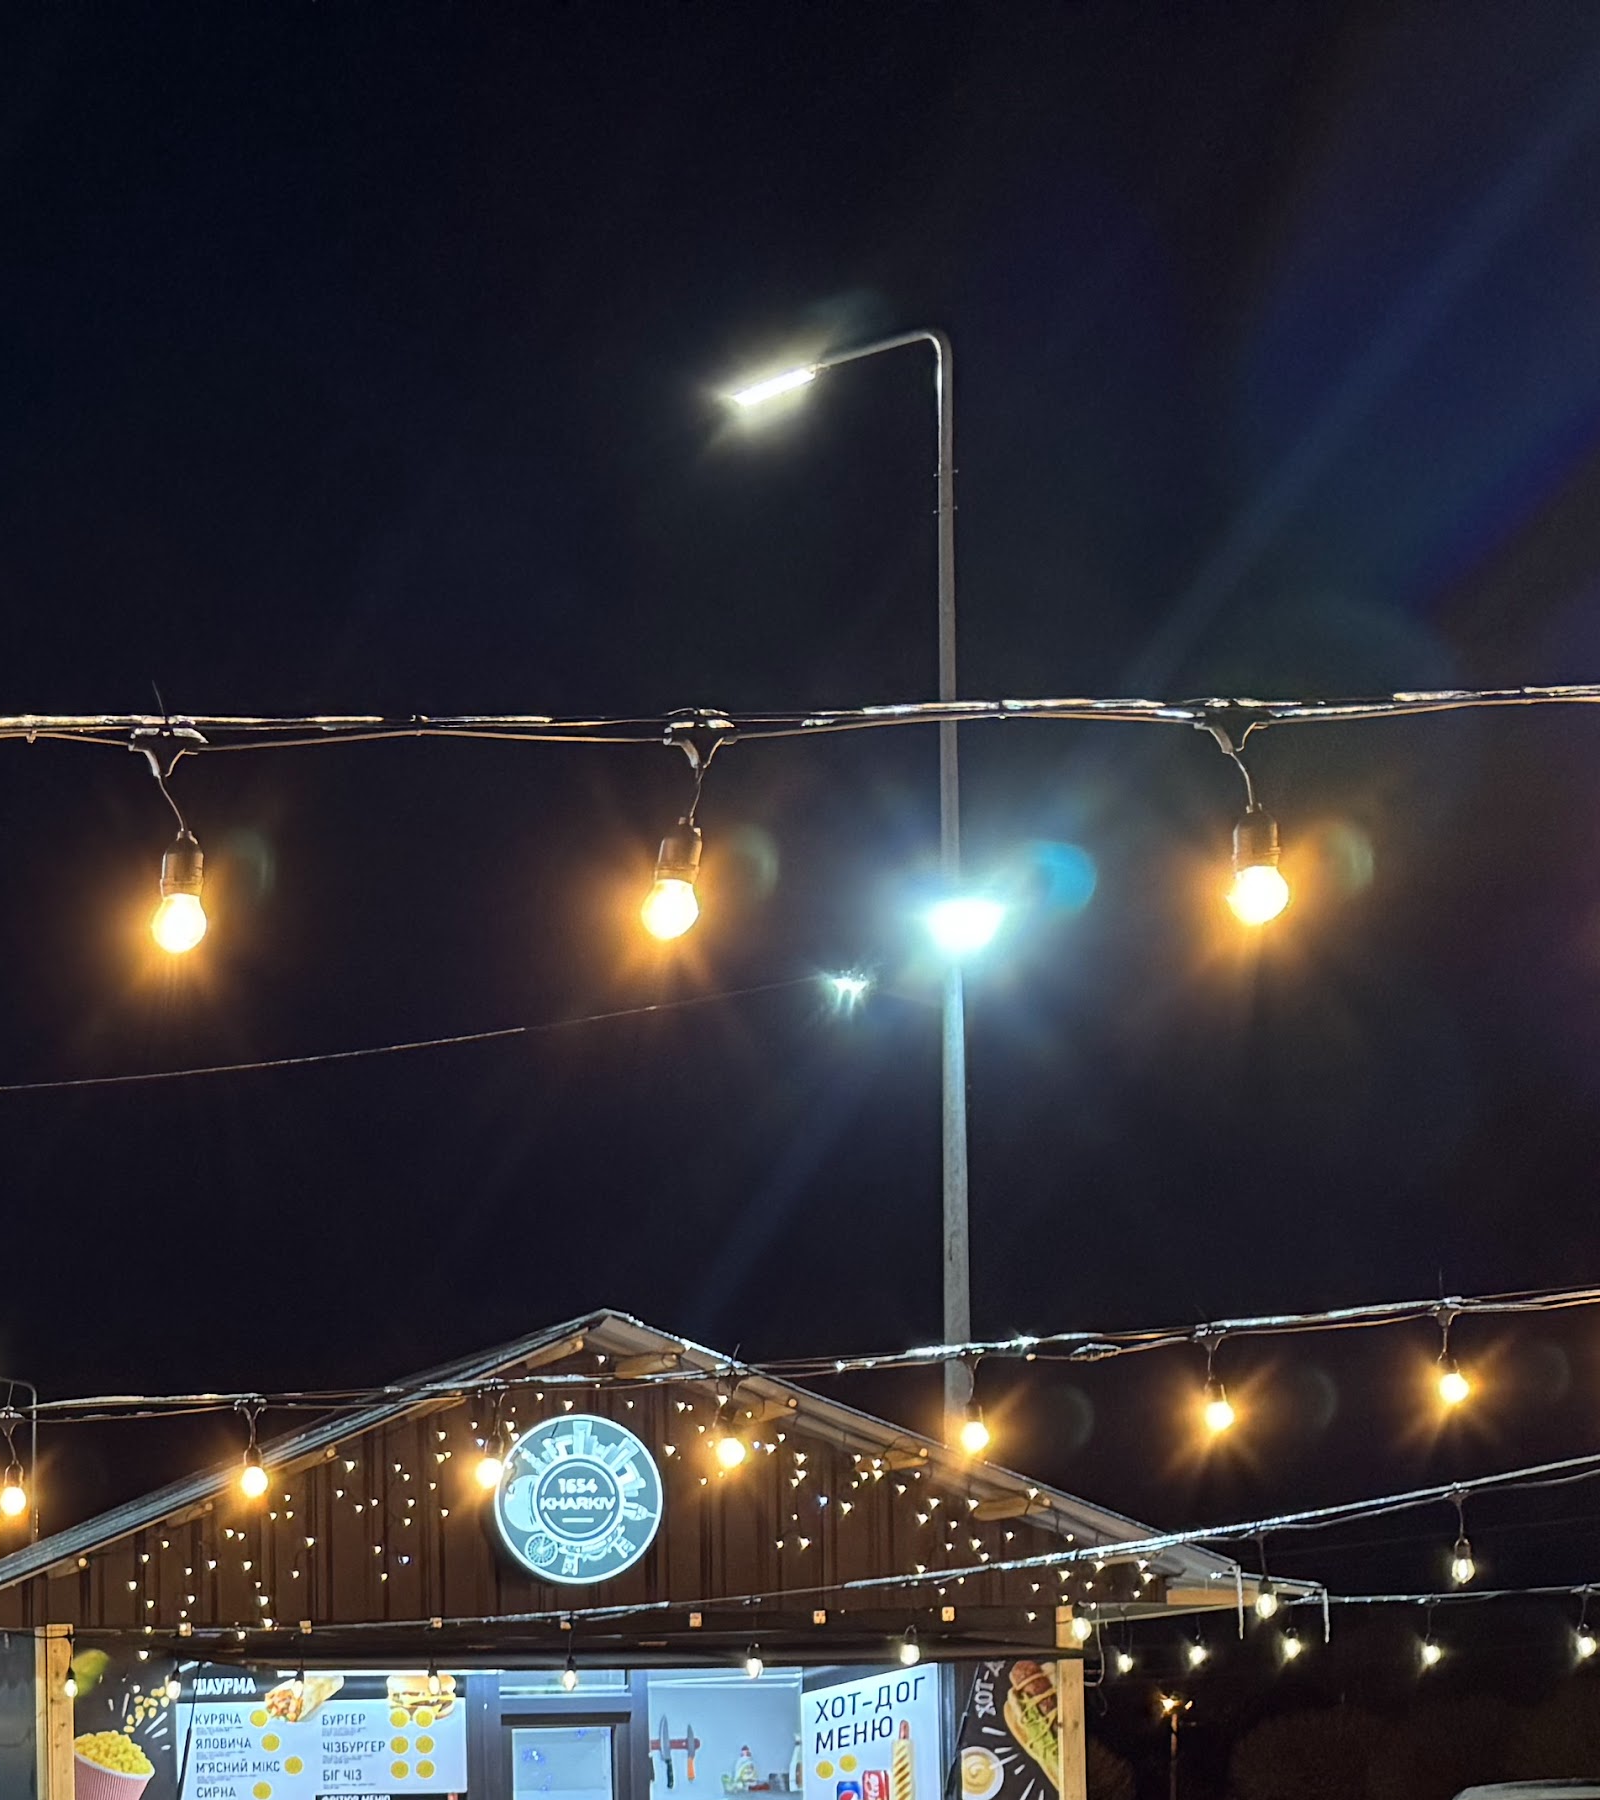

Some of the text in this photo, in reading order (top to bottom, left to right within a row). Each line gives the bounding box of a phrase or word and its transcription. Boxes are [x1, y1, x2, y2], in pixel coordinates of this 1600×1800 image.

[557, 1478, 599, 1494] 1654
[539, 1496, 617, 1511] KHARKIV
[193, 1677, 257, 1695] ШАУРМА
[815, 1676, 926, 1724] ХОТ-ДОГ
[195, 1713, 242, 1725] КУРЯЧА
[321, 1713, 366, 1725] БУРГЕР
[815, 1715, 894, 1754] МЕНЮ
[195, 1737, 252, 1749] ЯЛОВИЧА
[322, 1740, 386, 1753] ЧІЗБУРГЕР
[196, 1758, 281, 1774] М'ЯСНИЙ МІКС
[322, 1769, 362, 1781] БІГ ЧІЗ
[196, 1786, 237, 1798] СИРНА
